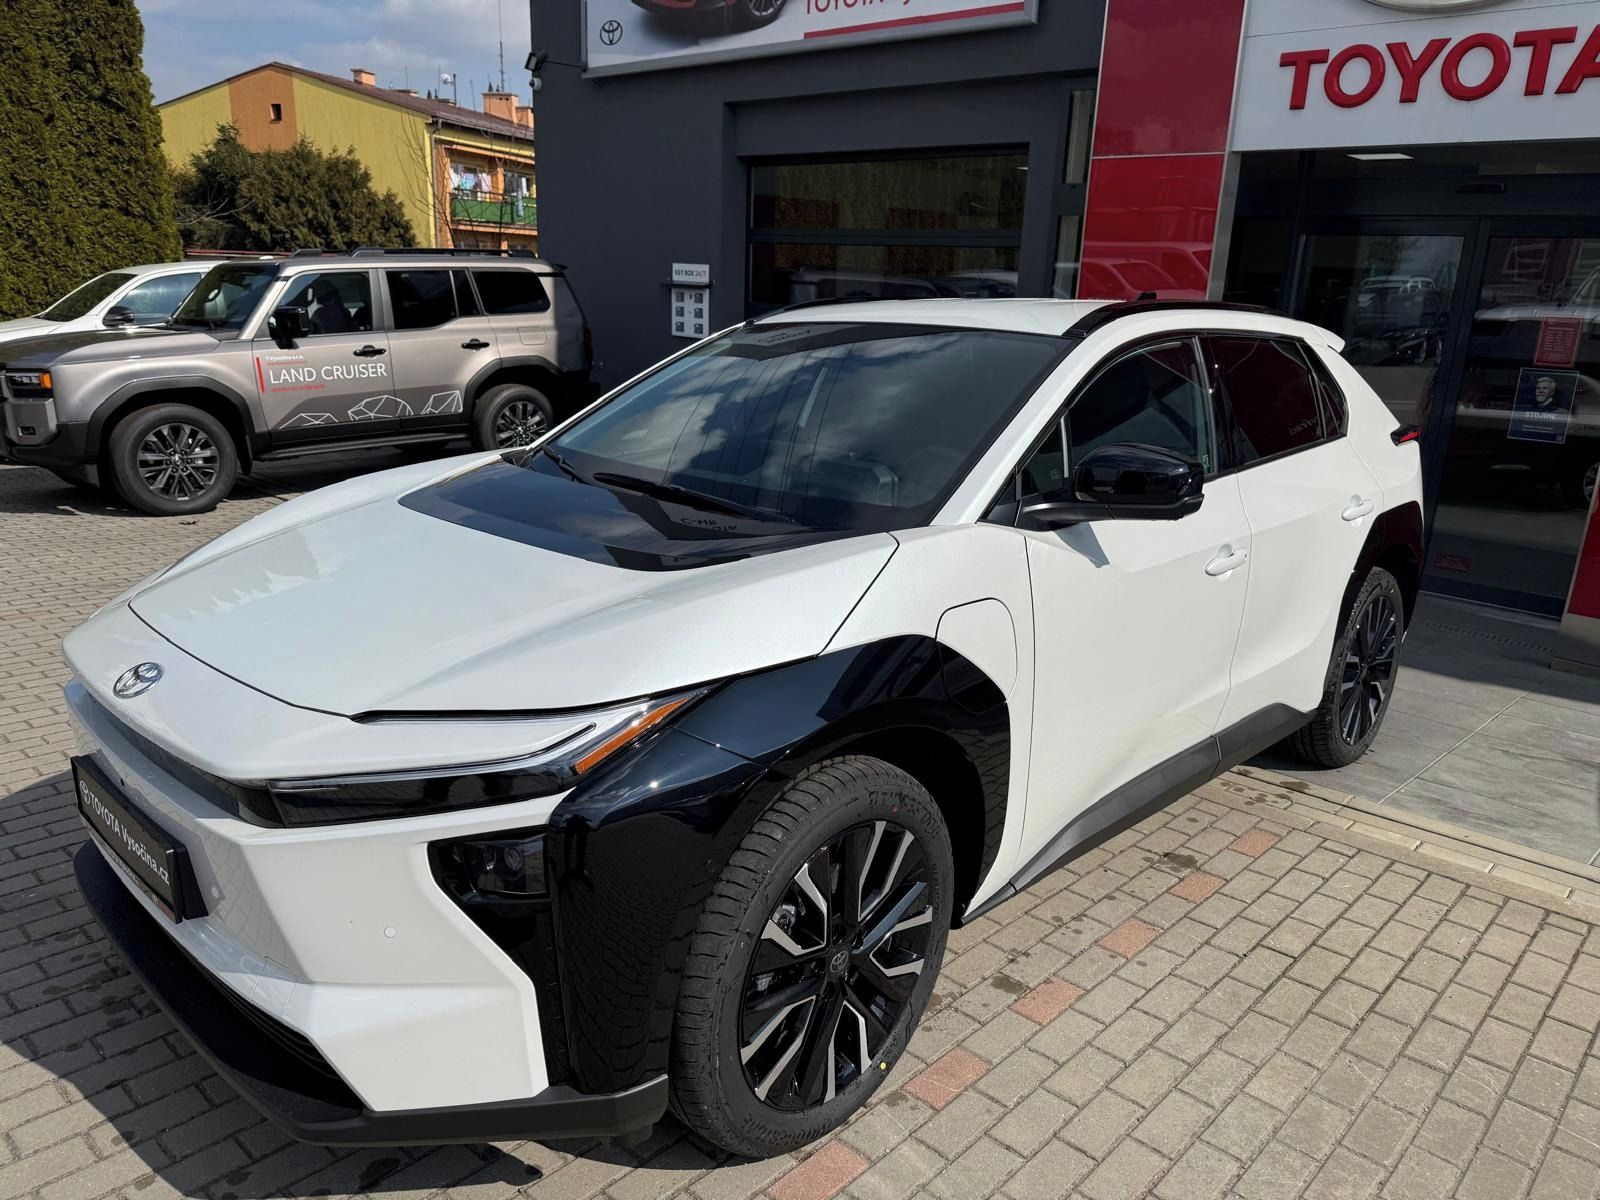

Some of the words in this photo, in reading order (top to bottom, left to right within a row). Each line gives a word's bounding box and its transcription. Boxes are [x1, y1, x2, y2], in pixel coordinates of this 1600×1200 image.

[806, 0, 884, 14] TOY
[684, 269, 694, 277] BOX
[269, 367, 316, 384] LAND
[321, 363, 387, 380] CRUISER
[90, 792, 121, 837] TOYOTA
[121, 825, 169, 885] Vysočina.cz
